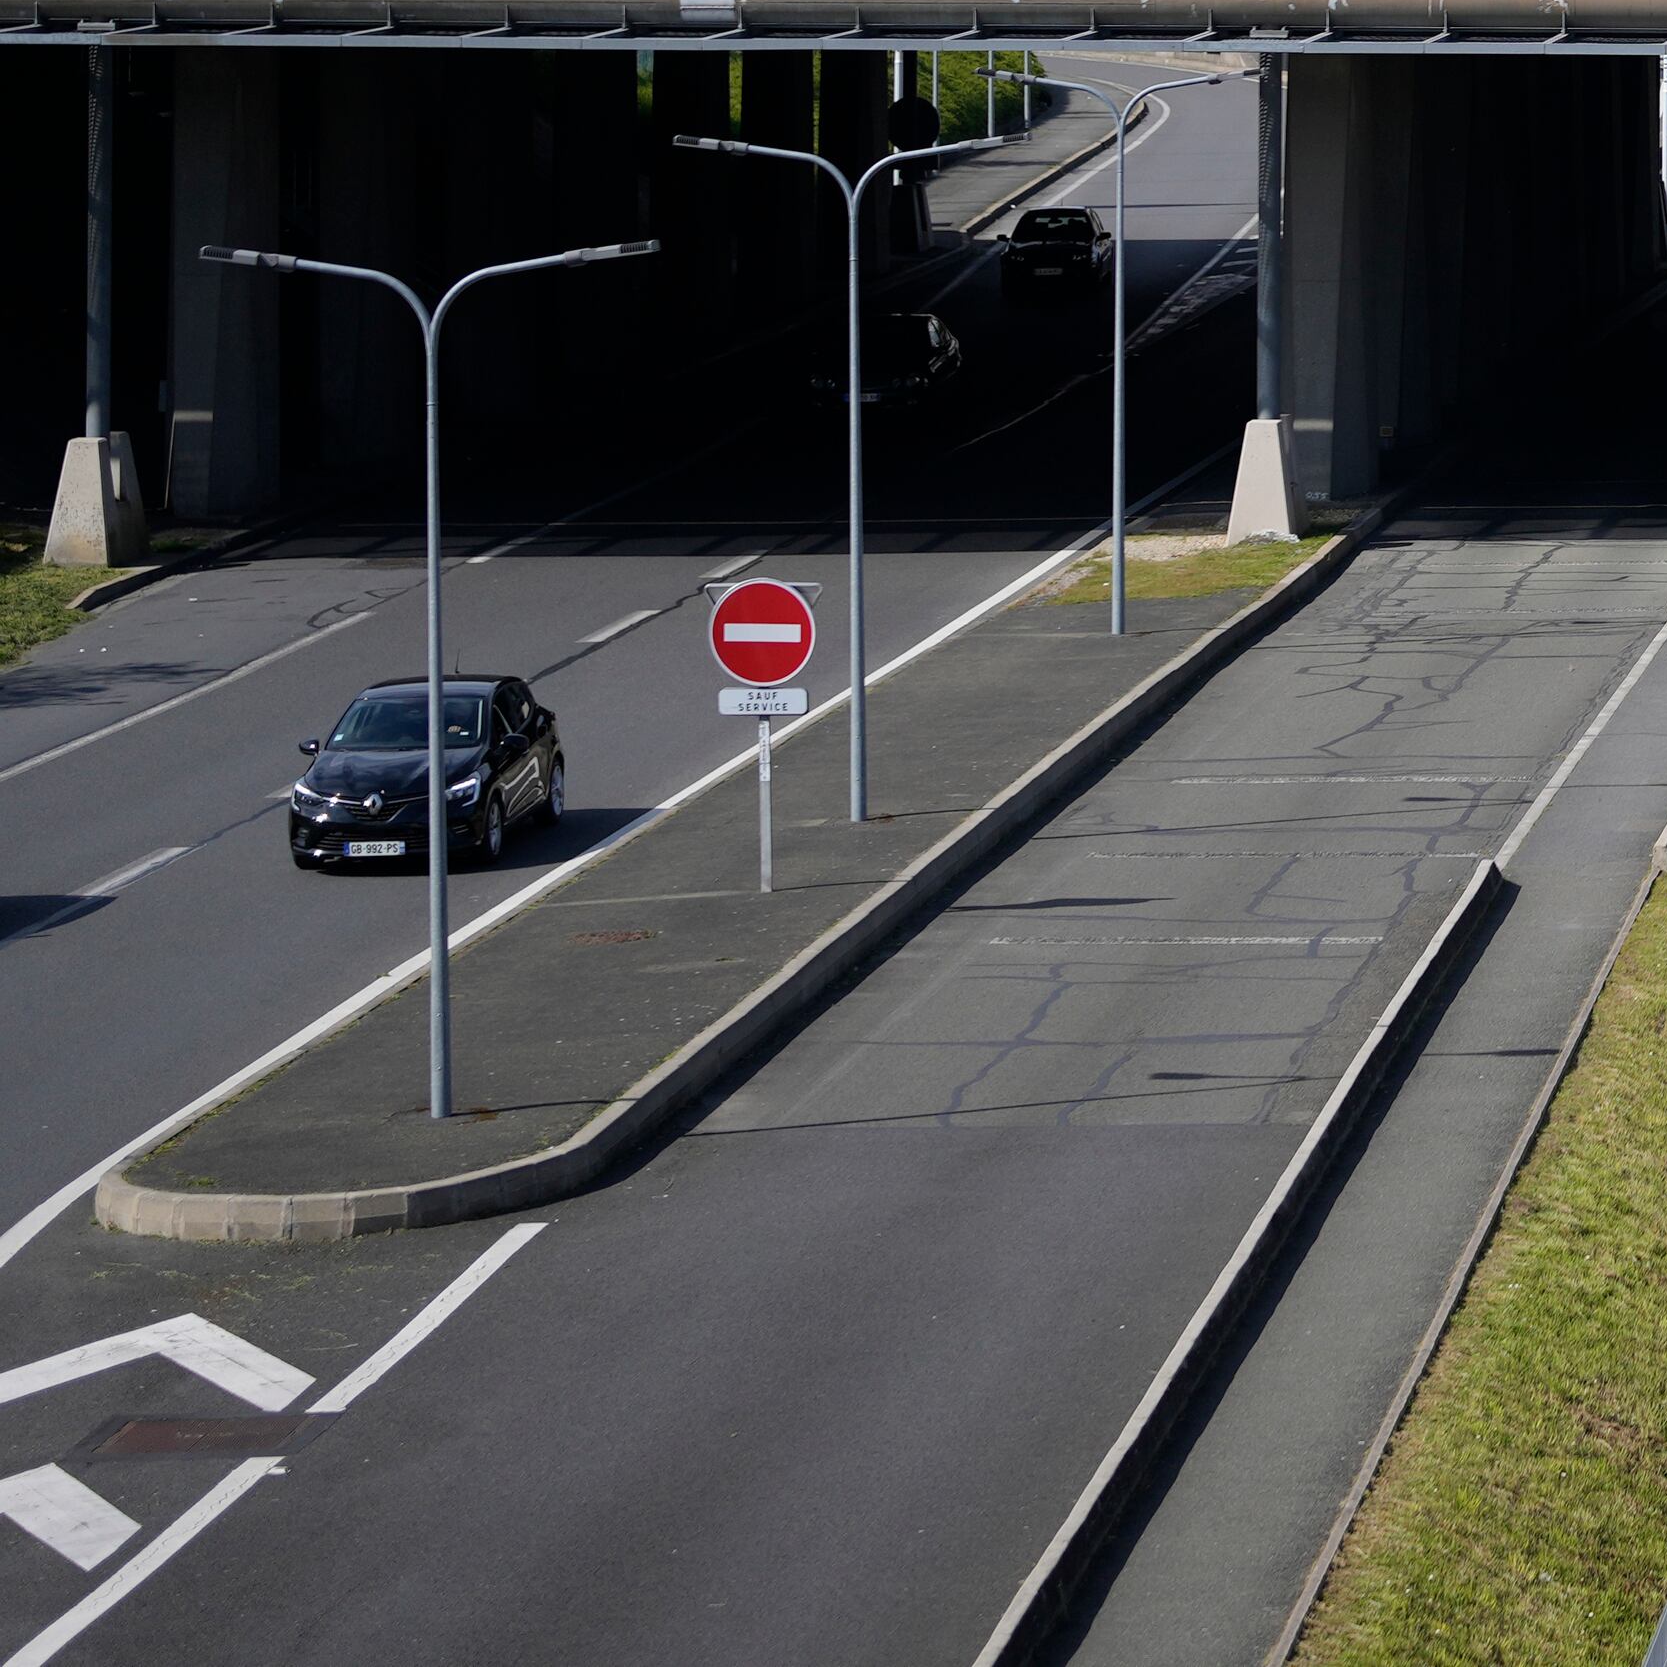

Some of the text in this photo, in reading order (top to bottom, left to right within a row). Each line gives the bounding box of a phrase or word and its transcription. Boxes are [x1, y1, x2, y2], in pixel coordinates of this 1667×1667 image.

[747, 691, 778, 700] SAUF
[738, 703, 789, 711] SERVICE
[351, 843, 399, 854] GB-992-PS
